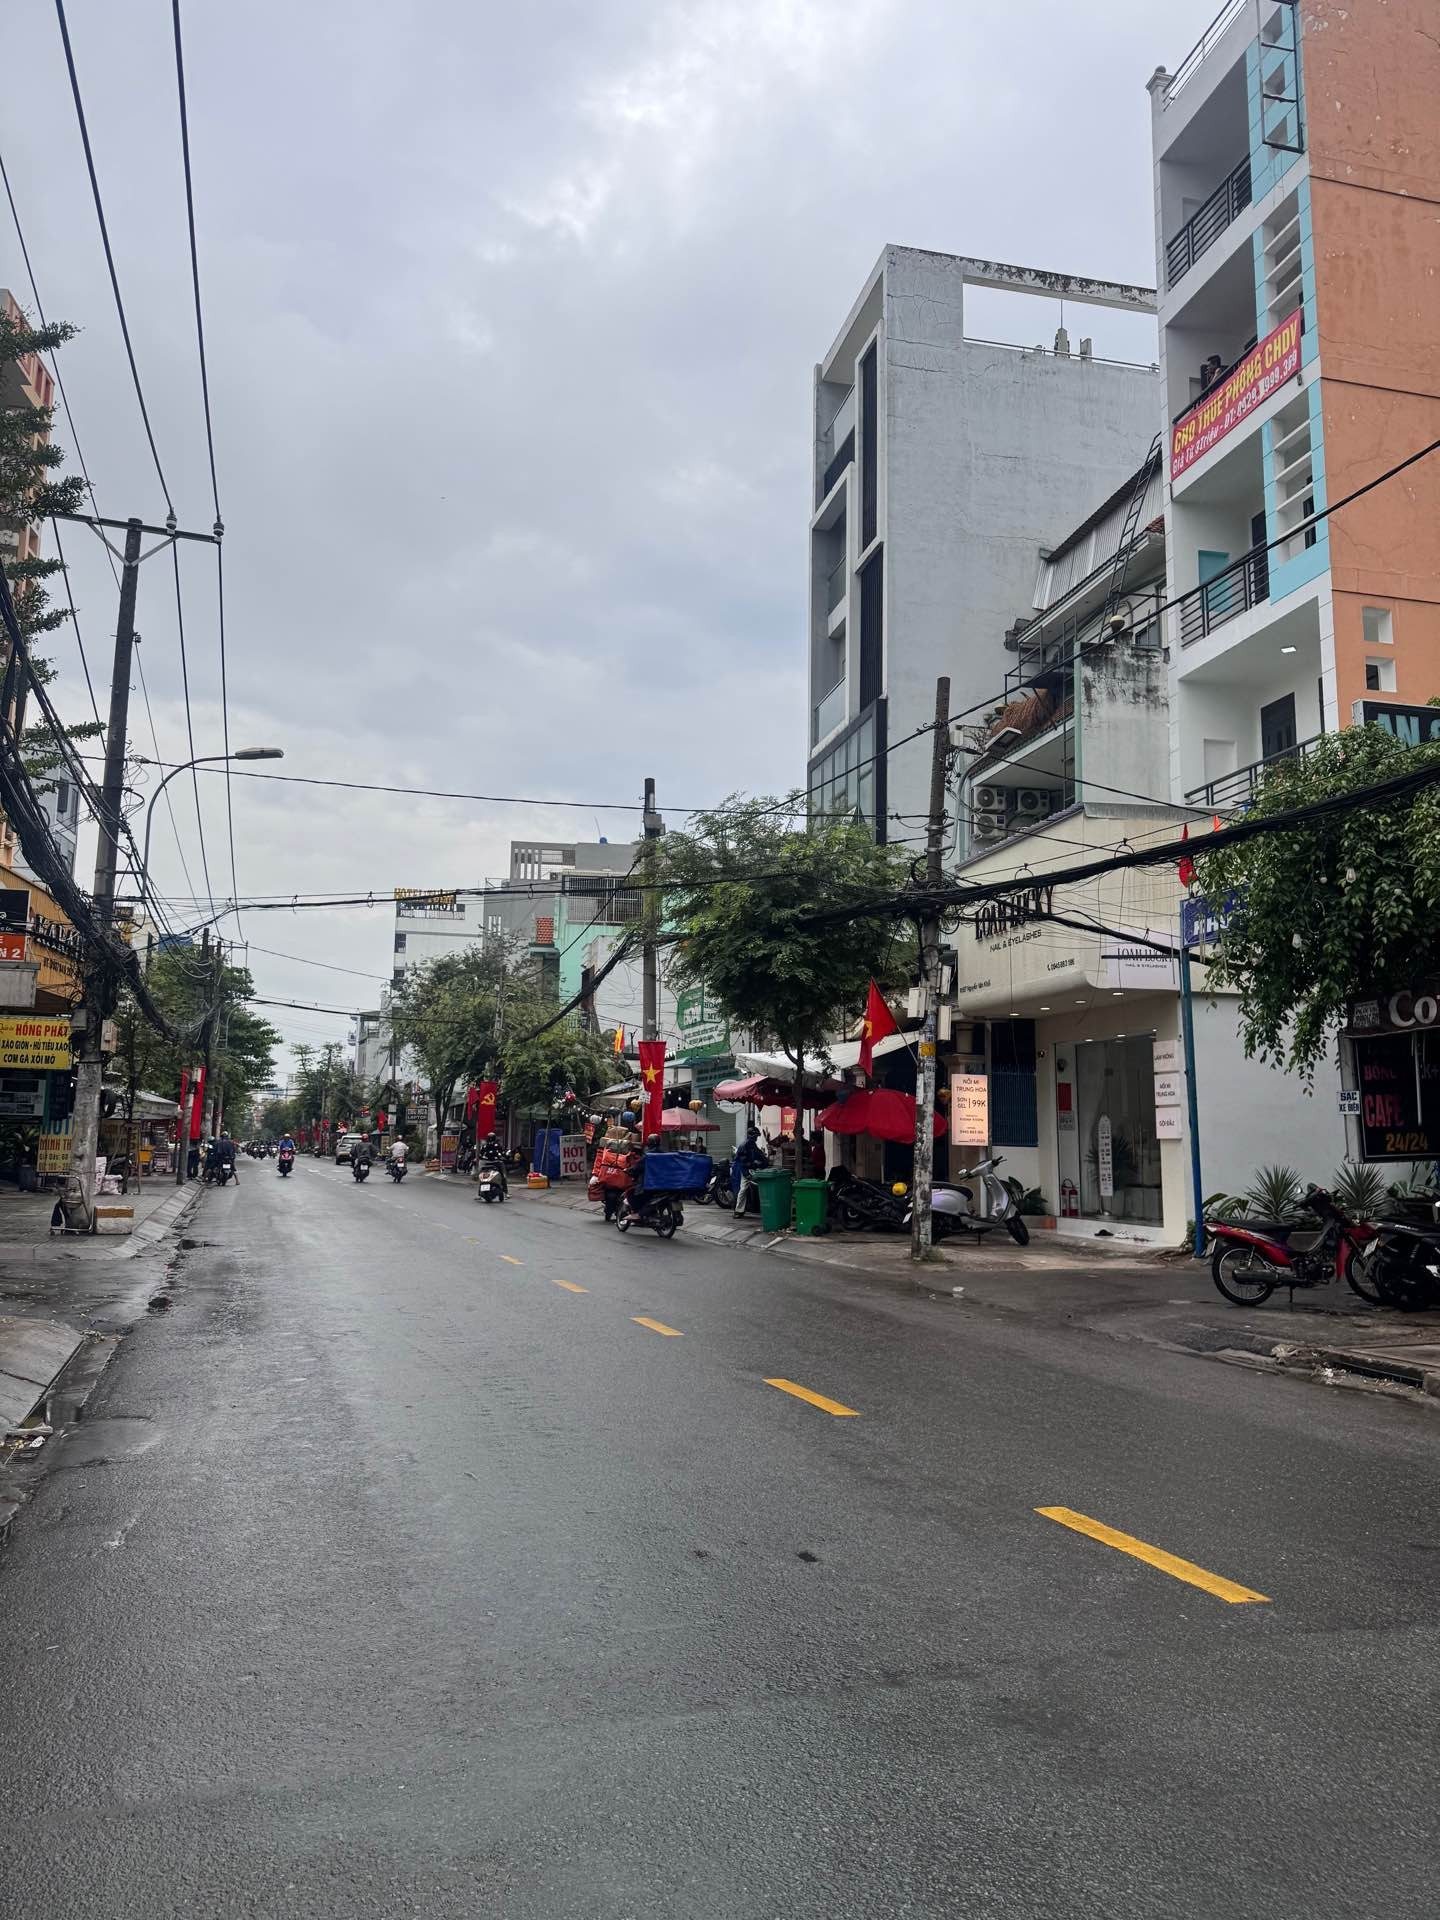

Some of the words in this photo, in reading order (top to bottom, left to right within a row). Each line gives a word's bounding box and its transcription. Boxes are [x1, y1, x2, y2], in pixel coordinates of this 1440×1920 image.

[1174, 419, 1196, 454] CHO
[1197, 392, 1224, 435] THUÊ
[1224, 355, 1262, 409] PHÒNG
[1264, 319, 1298, 369] CHDV
[989, 943, 1002, 953] NAIL
[1008, 929, 1042, 947] EYELASHES
[12, 948, 21, 958] 2
[44, 1022, 69, 1038] PHÁT
[971, 1099, 986, 1108] 99K
[1385, 1132, 1429, 1152] 24/24
[563, 1158, 585, 1174] TÓC
